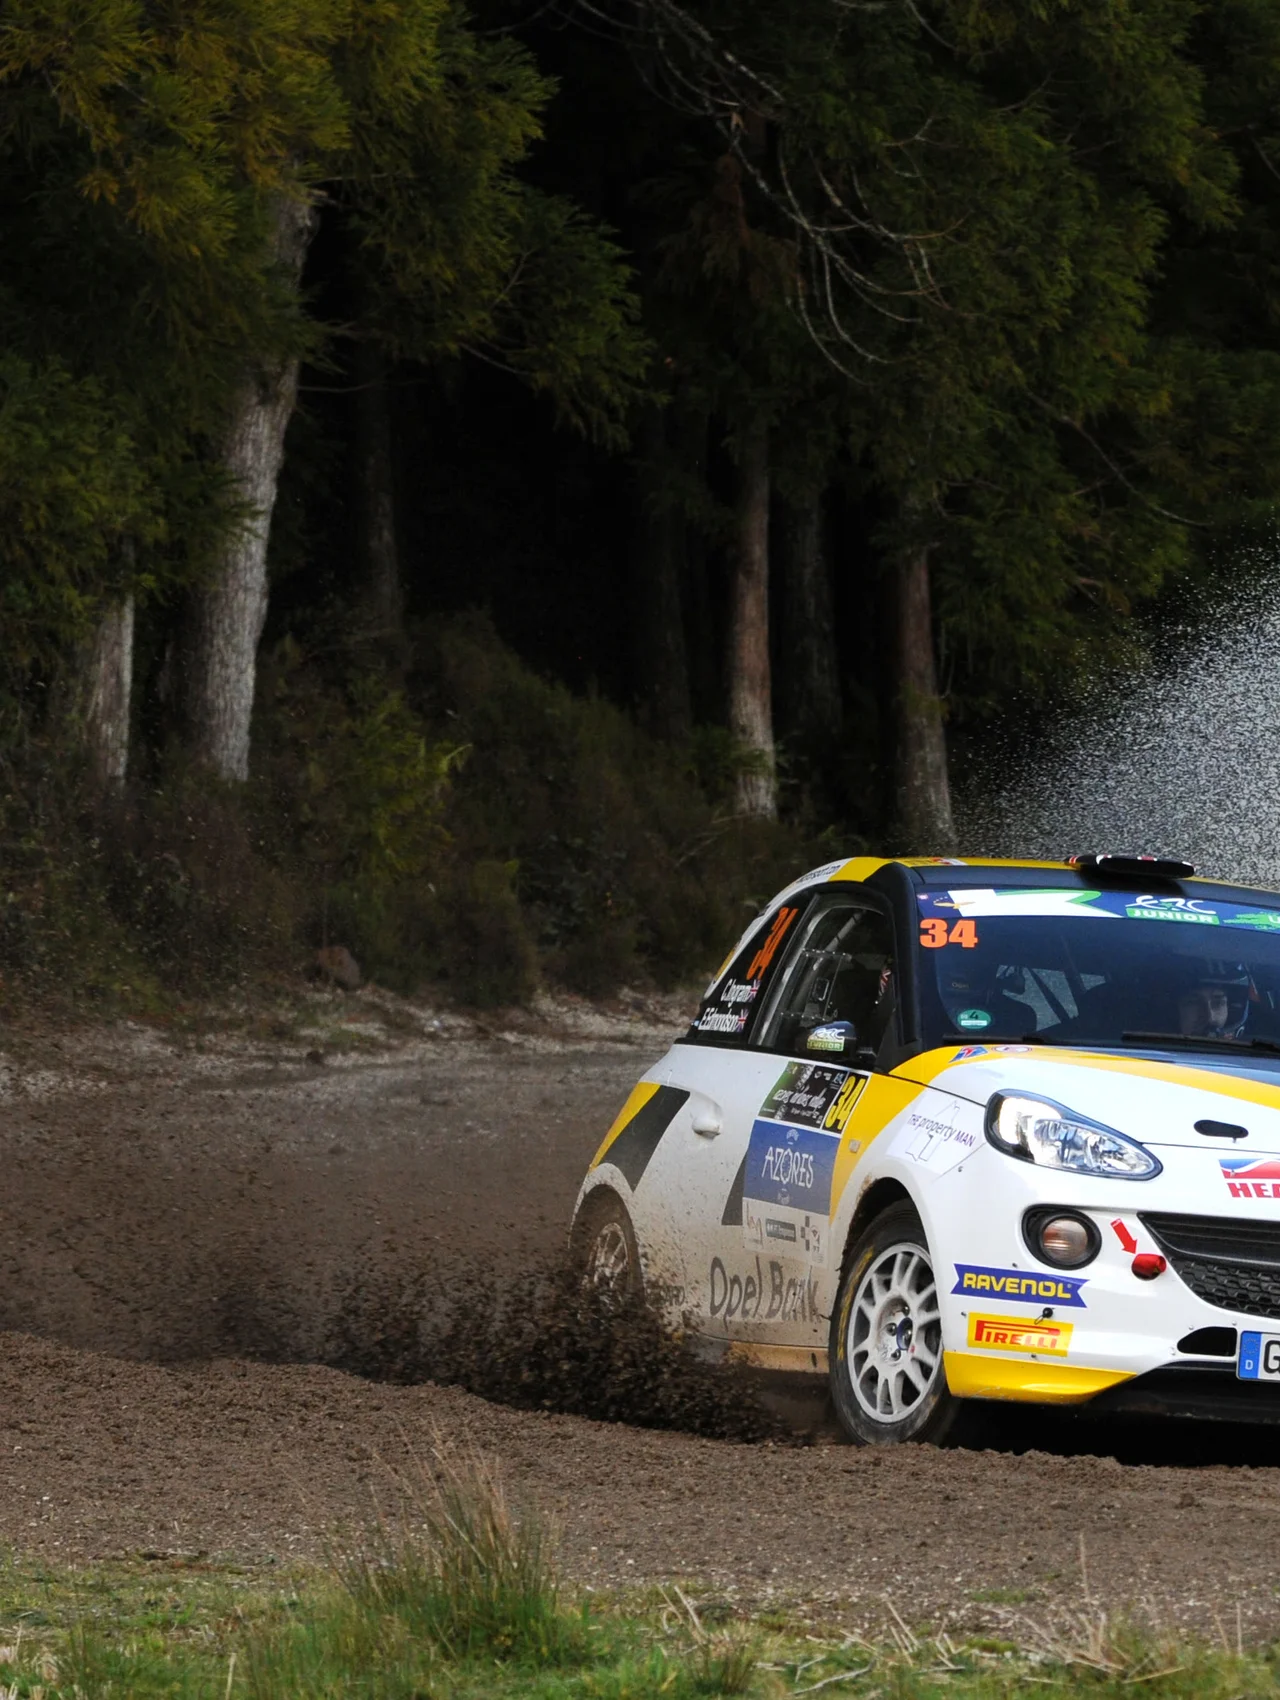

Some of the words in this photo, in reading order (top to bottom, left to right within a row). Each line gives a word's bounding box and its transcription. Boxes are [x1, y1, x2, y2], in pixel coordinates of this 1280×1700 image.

[1133, 909, 1214, 923] JUNIOR
[920, 918, 979, 948] 34
[969, 1011, 979, 1020] 4
[825, 1075, 867, 1130] 34
[915, 1117, 957, 1142] property
[954, 1130, 976, 1147] MAN
[761, 1146, 814, 1189] AZORES
[709, 1256, 763, 1332] Opel
[962, 1273, 1072, 1299] RAVENOL
[974, 1319, 1061, 1349] PIRELLI
[1245, 1359, 1254, 1371] D
